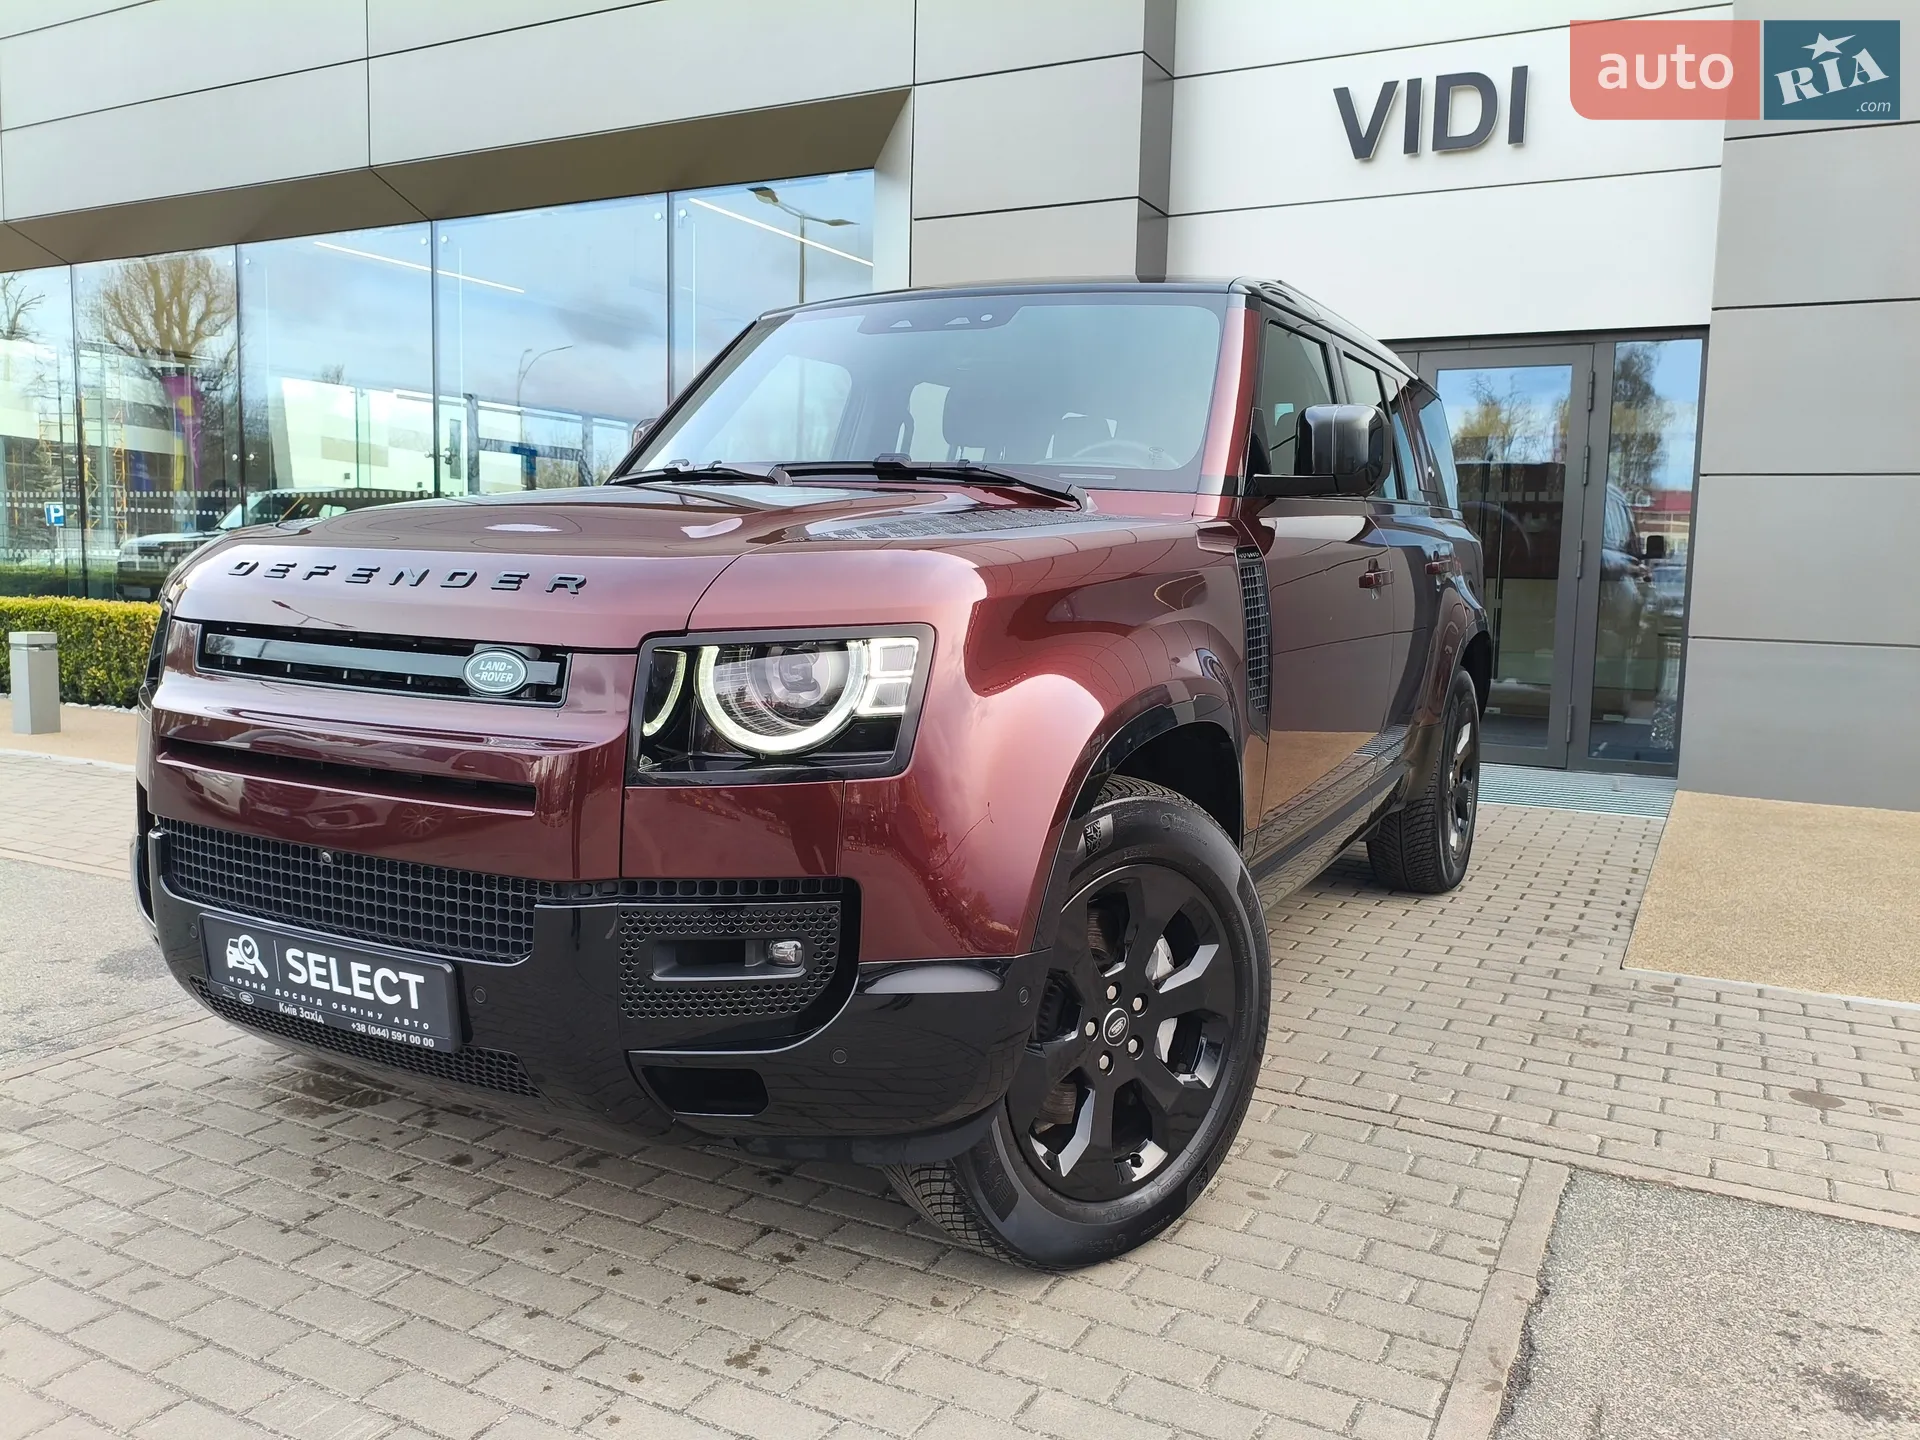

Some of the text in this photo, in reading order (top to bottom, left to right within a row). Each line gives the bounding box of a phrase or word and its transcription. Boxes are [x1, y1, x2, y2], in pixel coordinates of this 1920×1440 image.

[1333, 65, 1530, 161] VIDI
[49, 504, 64, 523] P
[228, 560, 587, 594] DEFENDER
[285, 947, 425, 1010] SELECT
[229, 975, 430, 1030] НОВИЙ ДОСВІД ОБМІНУ АВТО
[279, 1002, 325, 1024] Київ Захід
[351, 1021, 435, 1048] +38 (044) 591 00 00
